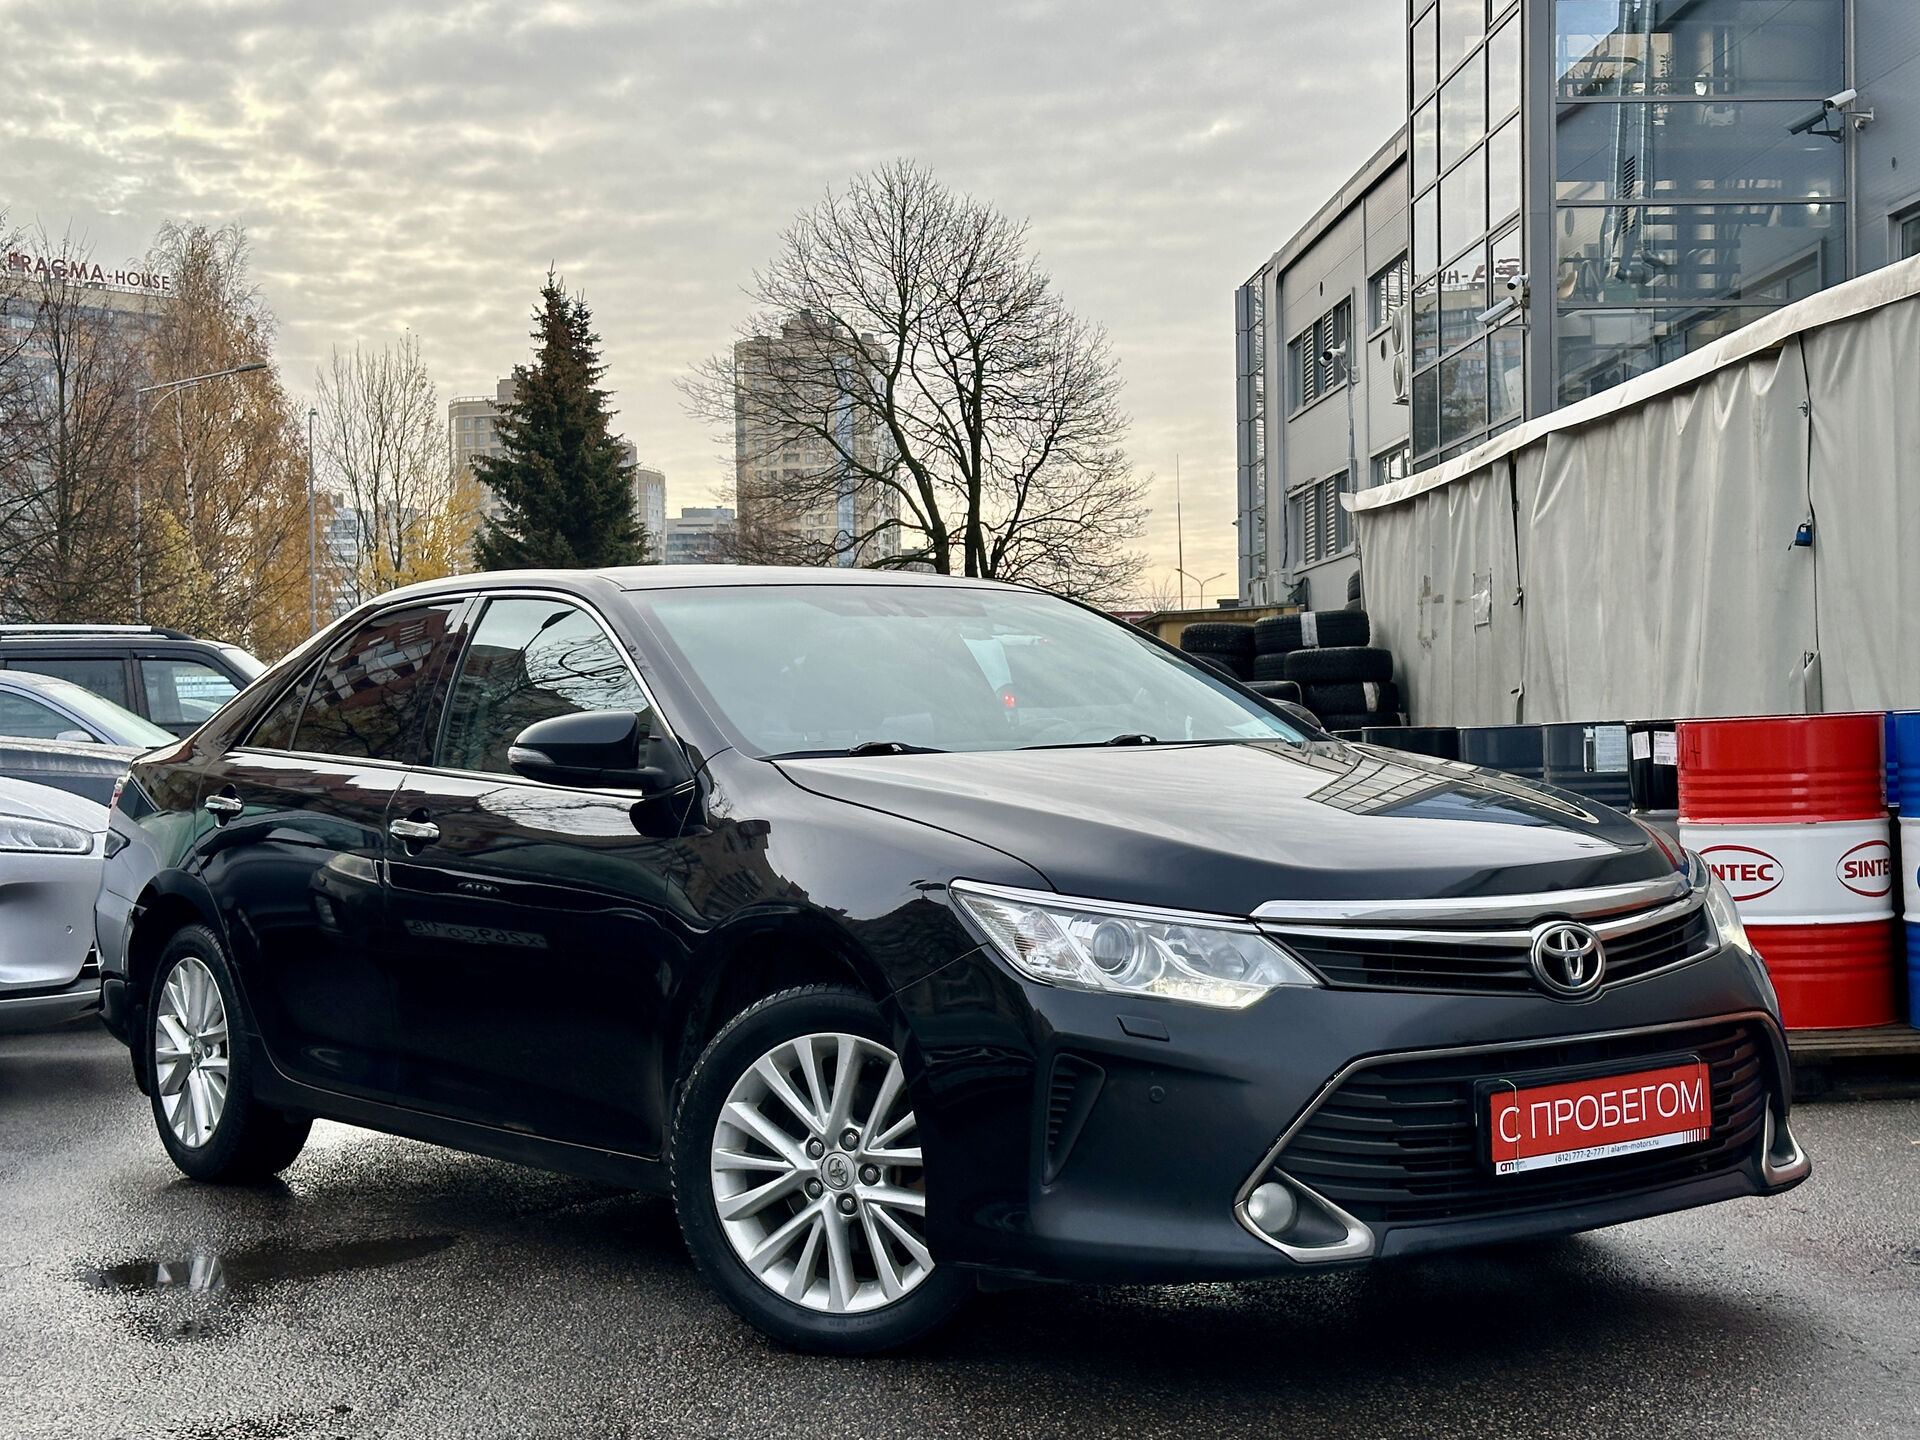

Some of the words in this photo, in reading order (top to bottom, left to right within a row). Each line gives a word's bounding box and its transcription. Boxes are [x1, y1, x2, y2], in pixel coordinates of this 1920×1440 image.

[1706, 864, 1774, 881] NTEC
[1844, 858, 1890, 879] SINTE
[1499, 1106, 1522, 1142] С
[1530, 1078, 1704, 1139] ПРОБЕГОМ
[1572, 1147, 1605, 1160] 777-2-777
[1611, 1139, 1659, 1153] alarm-motors.ru
